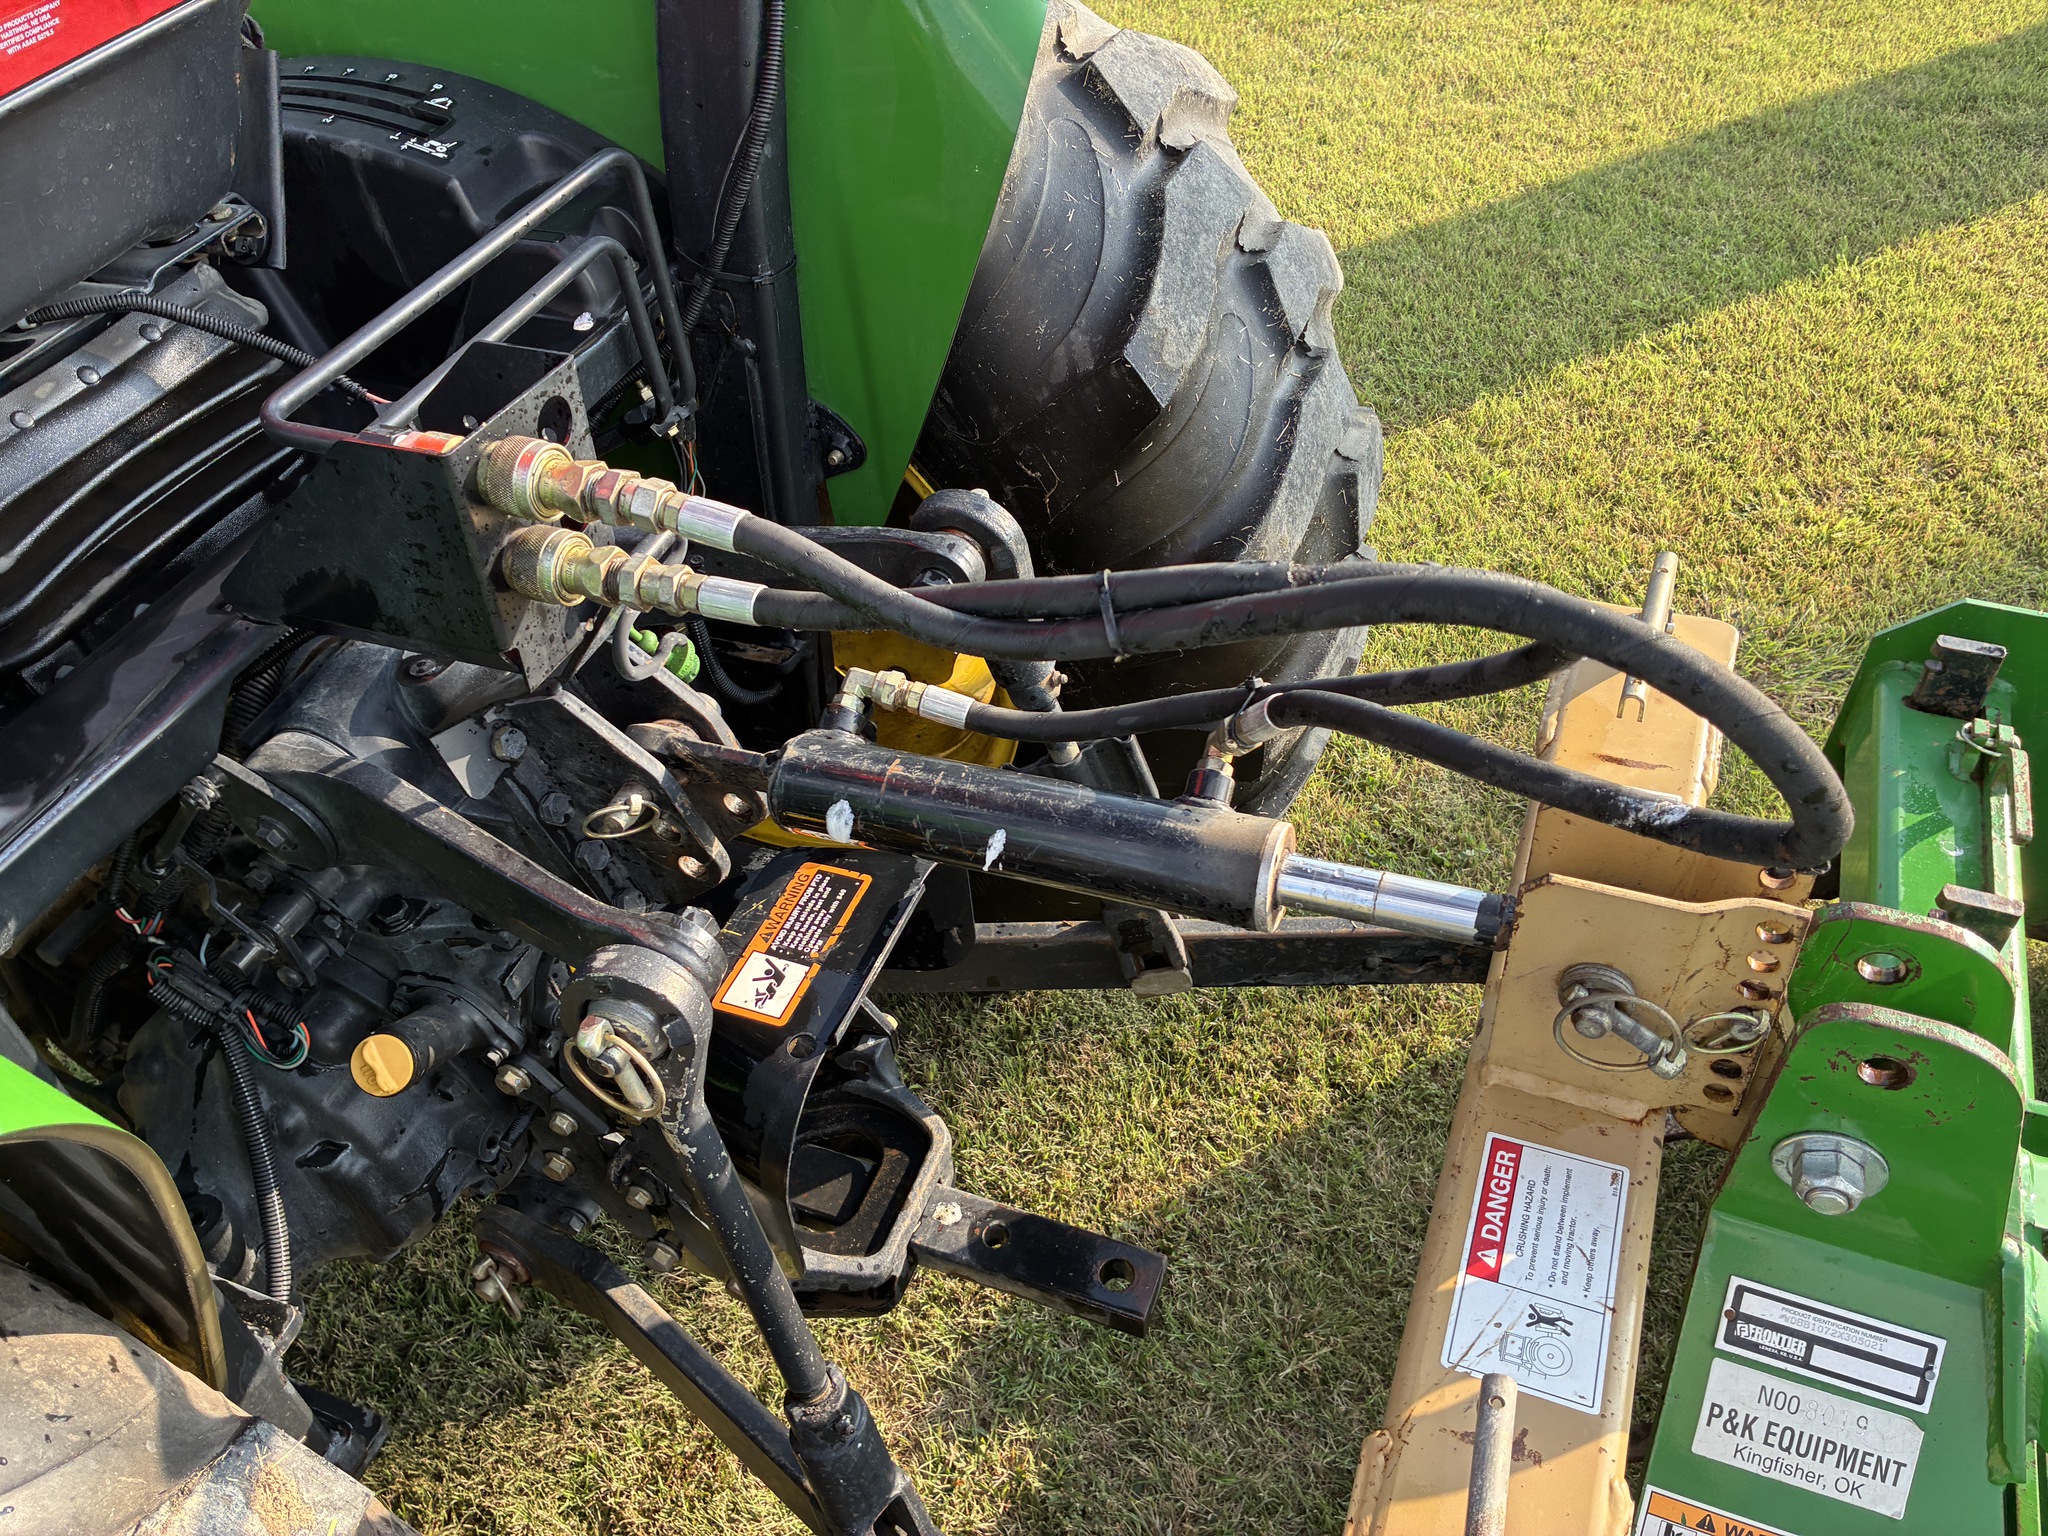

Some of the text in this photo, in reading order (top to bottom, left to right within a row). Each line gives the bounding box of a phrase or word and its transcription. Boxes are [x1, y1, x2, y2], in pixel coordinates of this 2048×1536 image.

[3, 12, 34, 30] PRODUCTS
[34, 0, 60, 16] COMPANY
[25, 17, 60, 38] COMPLIANCE
[30, 18, 39, 26] NE
[40, 13, 51, 22] USA
[6, 45, 21, 55] WITH
[765, 873, 810, 931] WARNING
[771, 874, 822, 950] AVOID INJURY FROM PTO
[783, 931, 796, 947] Keep
[818, 876, 830, 892] place
[790, 933, 803, 949] Keep
[822, 886, 832, 899] and
[797, 908, 827, 950] clothing away
[804, 928, 823, 953] Operate
[820, 913, 832, 928] only
[828, 900, 840, 913] with
[1481, 1150, 1517, 1242] DANGER
[1561, 1168, 1574, 1204] implement
[1515, 1179, 1536, 1258] CRUSHING HAZARD
[1525, 1164, 1552, 1282] To prevent serious injury or death:
[1557, 1204, 1567, 1235] between
[1568, 1216, 1578, 1242] tractor.
[1554, 1235, 1562, 1257] stand
[1564, 1242, 1575, 1270] moving
[1548, 1272, 1556, 1283] Do
[1582, 1272, 1592, 1293] Keep
[1587, 1245, 1597, 1271] others
[1749, 1323, 1807, 1357] FRONTIER
[1781, 1306, 1888, 1343] PRODUCT IDENTIFICATION NUMBER
[1706, 1401, 1907, 1487] P&K EQUIPMENT
[1733, 1443, 1865, 1499] Kingfisher, OK
